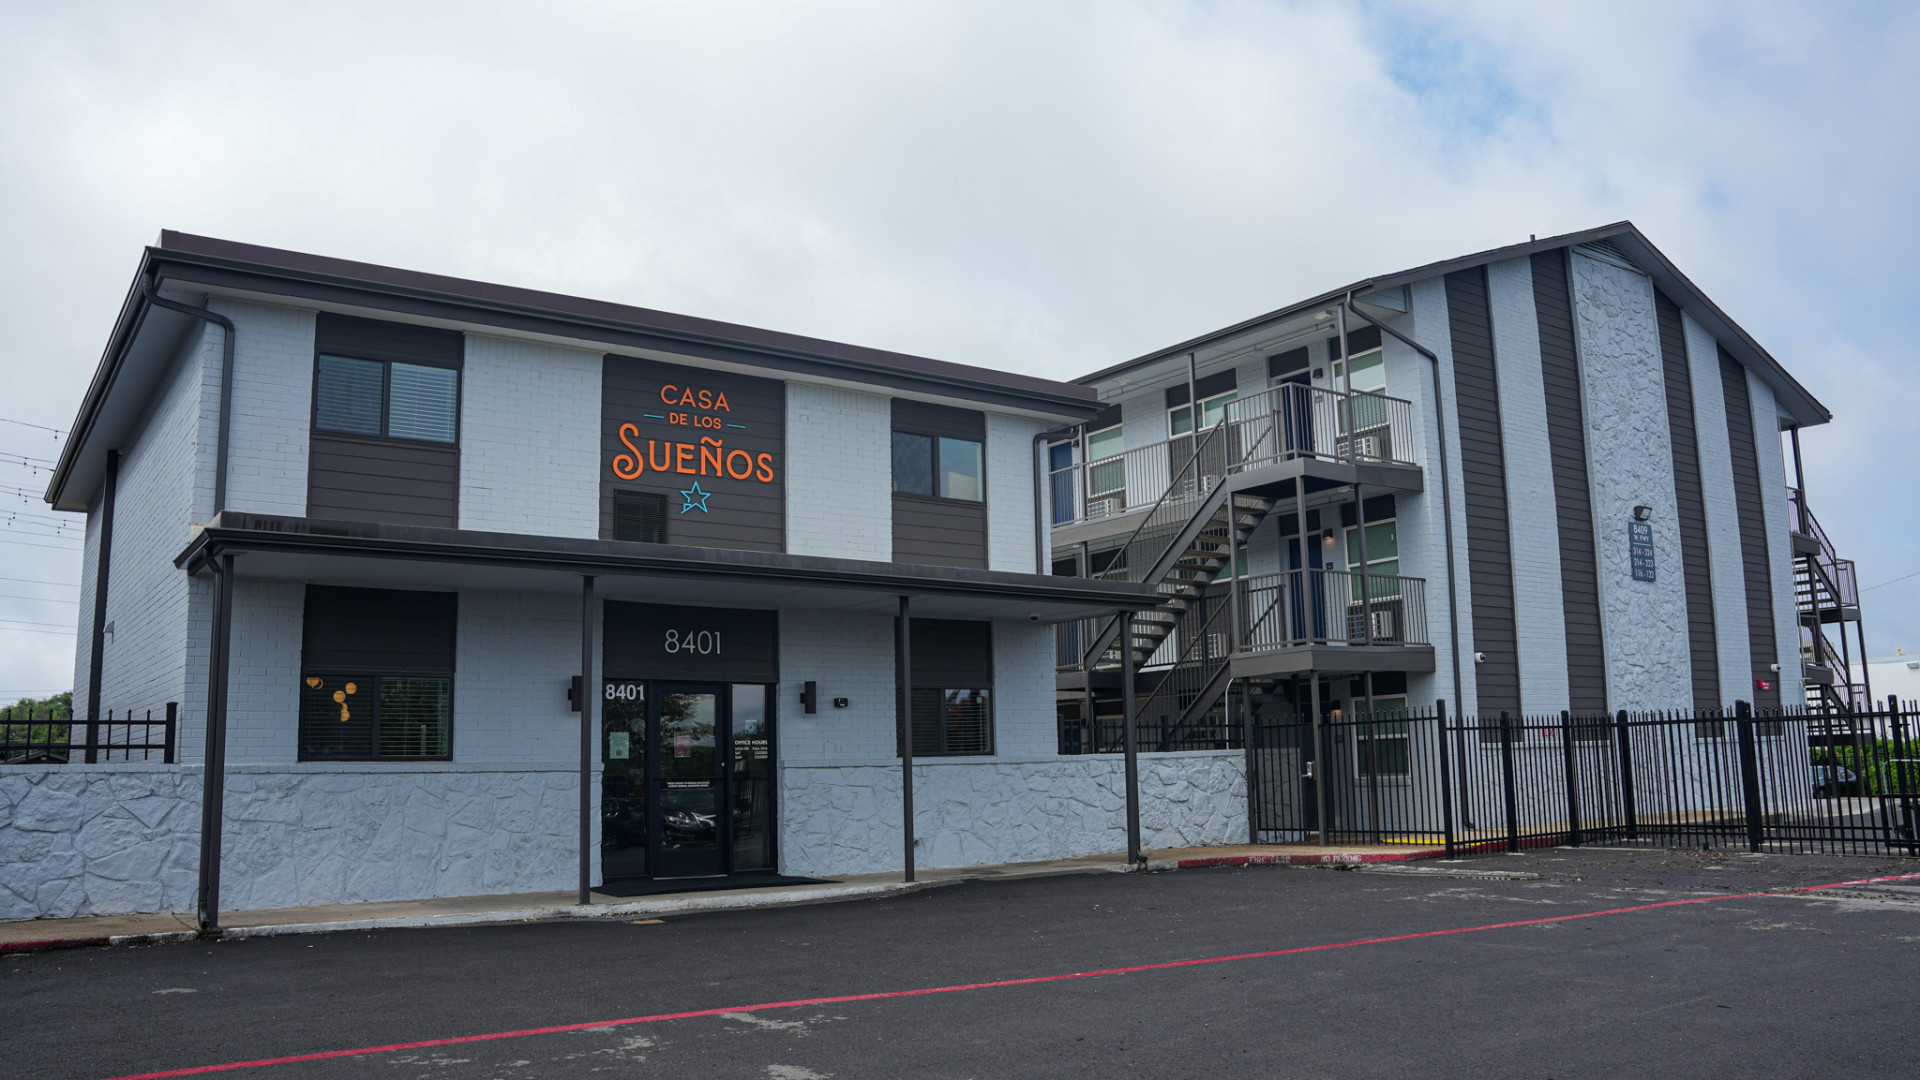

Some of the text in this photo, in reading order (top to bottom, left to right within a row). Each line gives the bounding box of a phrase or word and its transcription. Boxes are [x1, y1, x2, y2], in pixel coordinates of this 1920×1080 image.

[661, 385, 730, 412] CASA
[669, 412, 722, 430] DE LOS
[612, 423, 774, 483] SUEÑOS
[1633, 524, 1648, 535] 8409
[664, 629, 721, 655] 8401
[605, 684, 645, 701] 8401
